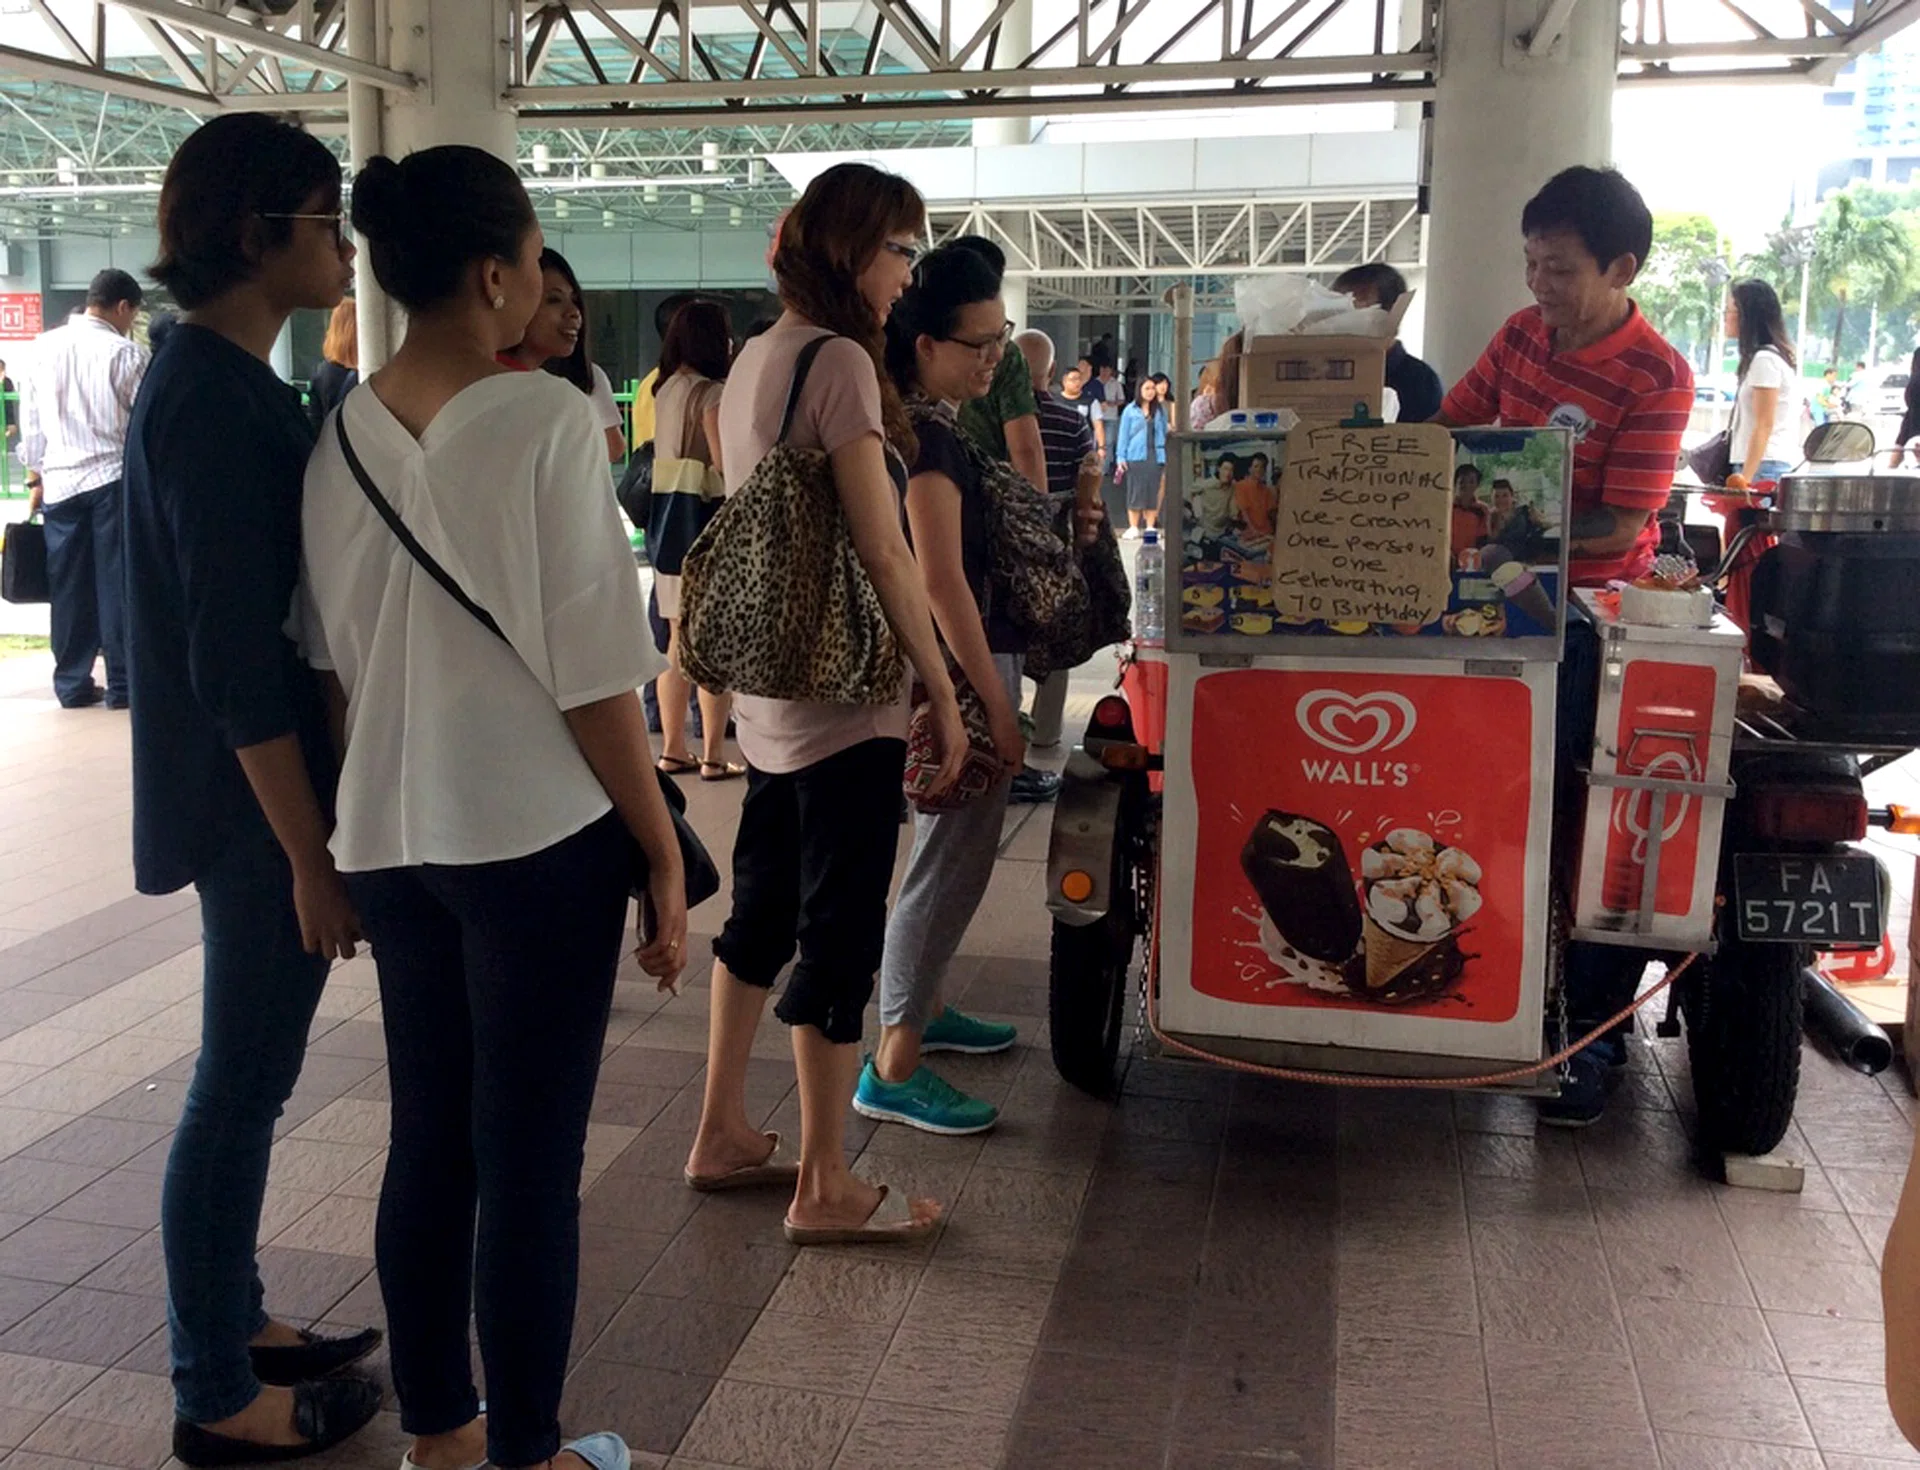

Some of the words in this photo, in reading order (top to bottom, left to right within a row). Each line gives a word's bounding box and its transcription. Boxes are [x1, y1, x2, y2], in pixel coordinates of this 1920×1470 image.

[1307, 425, 1422, 453] FREE
[1331, 452, 1389, 467] 700
[1289, 594, 1323, 613] 70
[1331, 597, 1433, 625] Birthday
[1300, 758, 1409, 787] WALL'S
[1781, 862, 1833, 895] FA
[1745, 901, 1873, 936] 5721T
